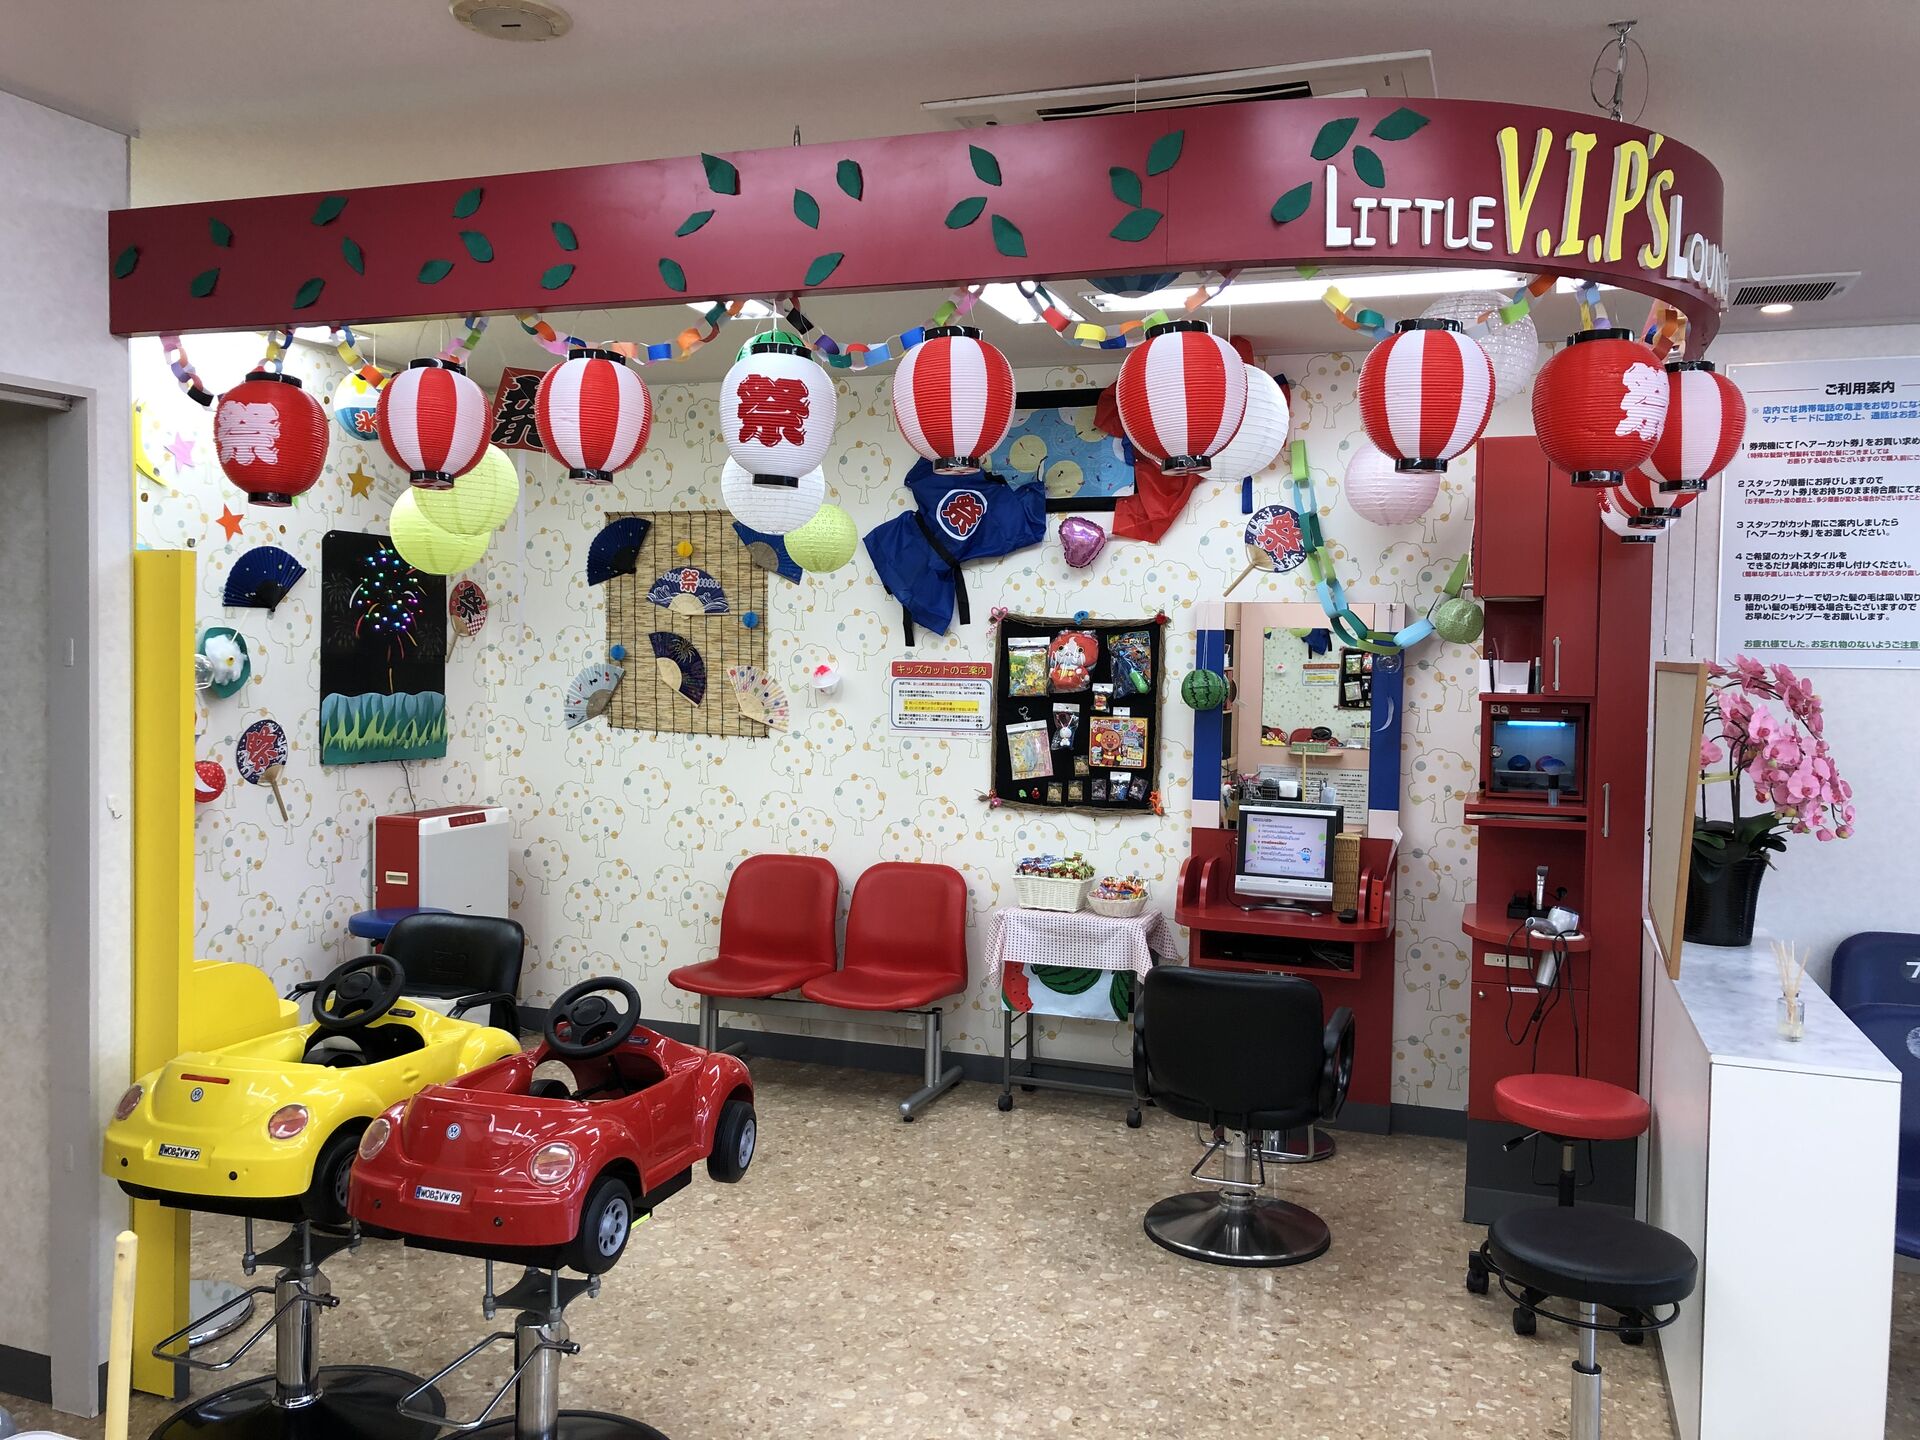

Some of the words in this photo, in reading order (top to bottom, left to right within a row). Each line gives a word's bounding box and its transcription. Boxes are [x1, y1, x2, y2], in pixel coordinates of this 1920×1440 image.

[1667, 194, 1729, 313] LOUN
[1762, 401, 1920, 415] 店内では携帯電話の電源をお切りにな
[1825, 381, 1896, 396] ご利用案内
[737, 374, 811, 447] 祭
[217, 400, 282, 466] 祭
[942, 493, 985, 536] 祭
[679, 569, 700, 593] 祭
[897, 664, 987, 676] キッズカットのご案内
[246, 725, 282, 771] 祭
